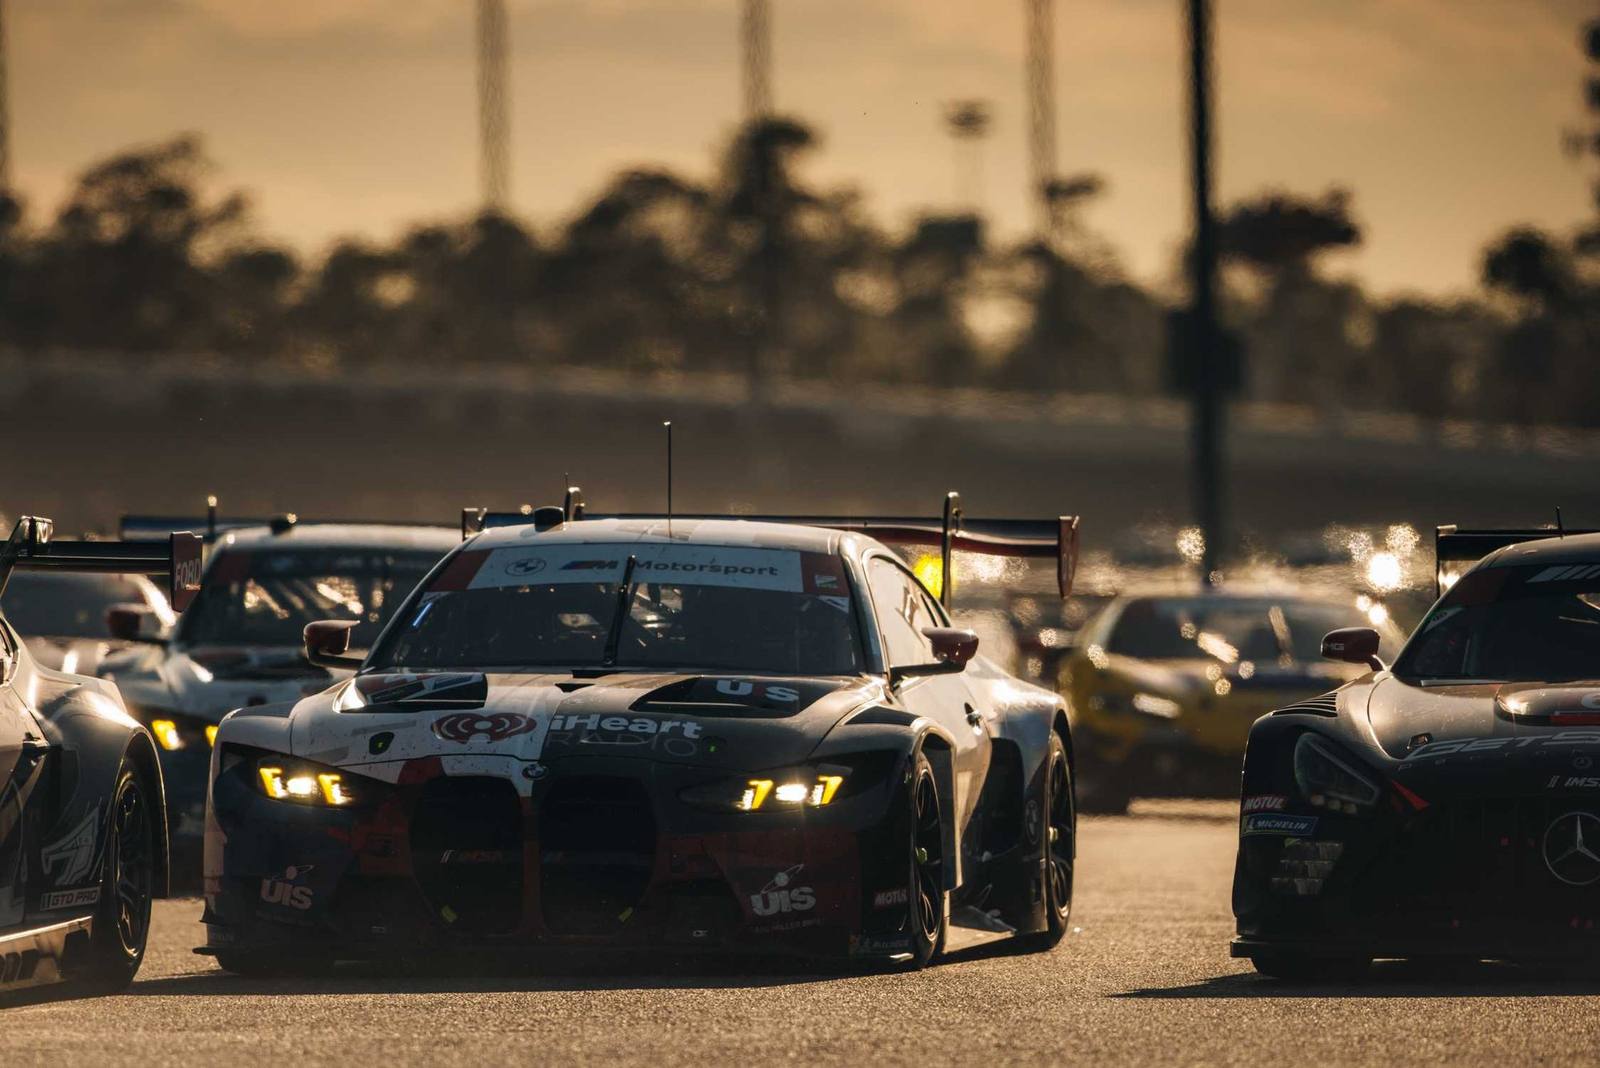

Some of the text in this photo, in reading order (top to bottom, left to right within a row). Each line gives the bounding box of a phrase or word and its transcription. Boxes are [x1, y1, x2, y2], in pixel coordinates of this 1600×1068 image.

[174, 559, 202, 591] FORD
[635, 561, 779, 578] Motorsport
[550, 714, 703, 740] iHeart
[546, 733, 699, 757] RADIO
[1564, 777, 1600, 787] IMS
[1243, 797, 1286, 810] MOTUL
[1256, 820, 1310, 831] MICHELIN
